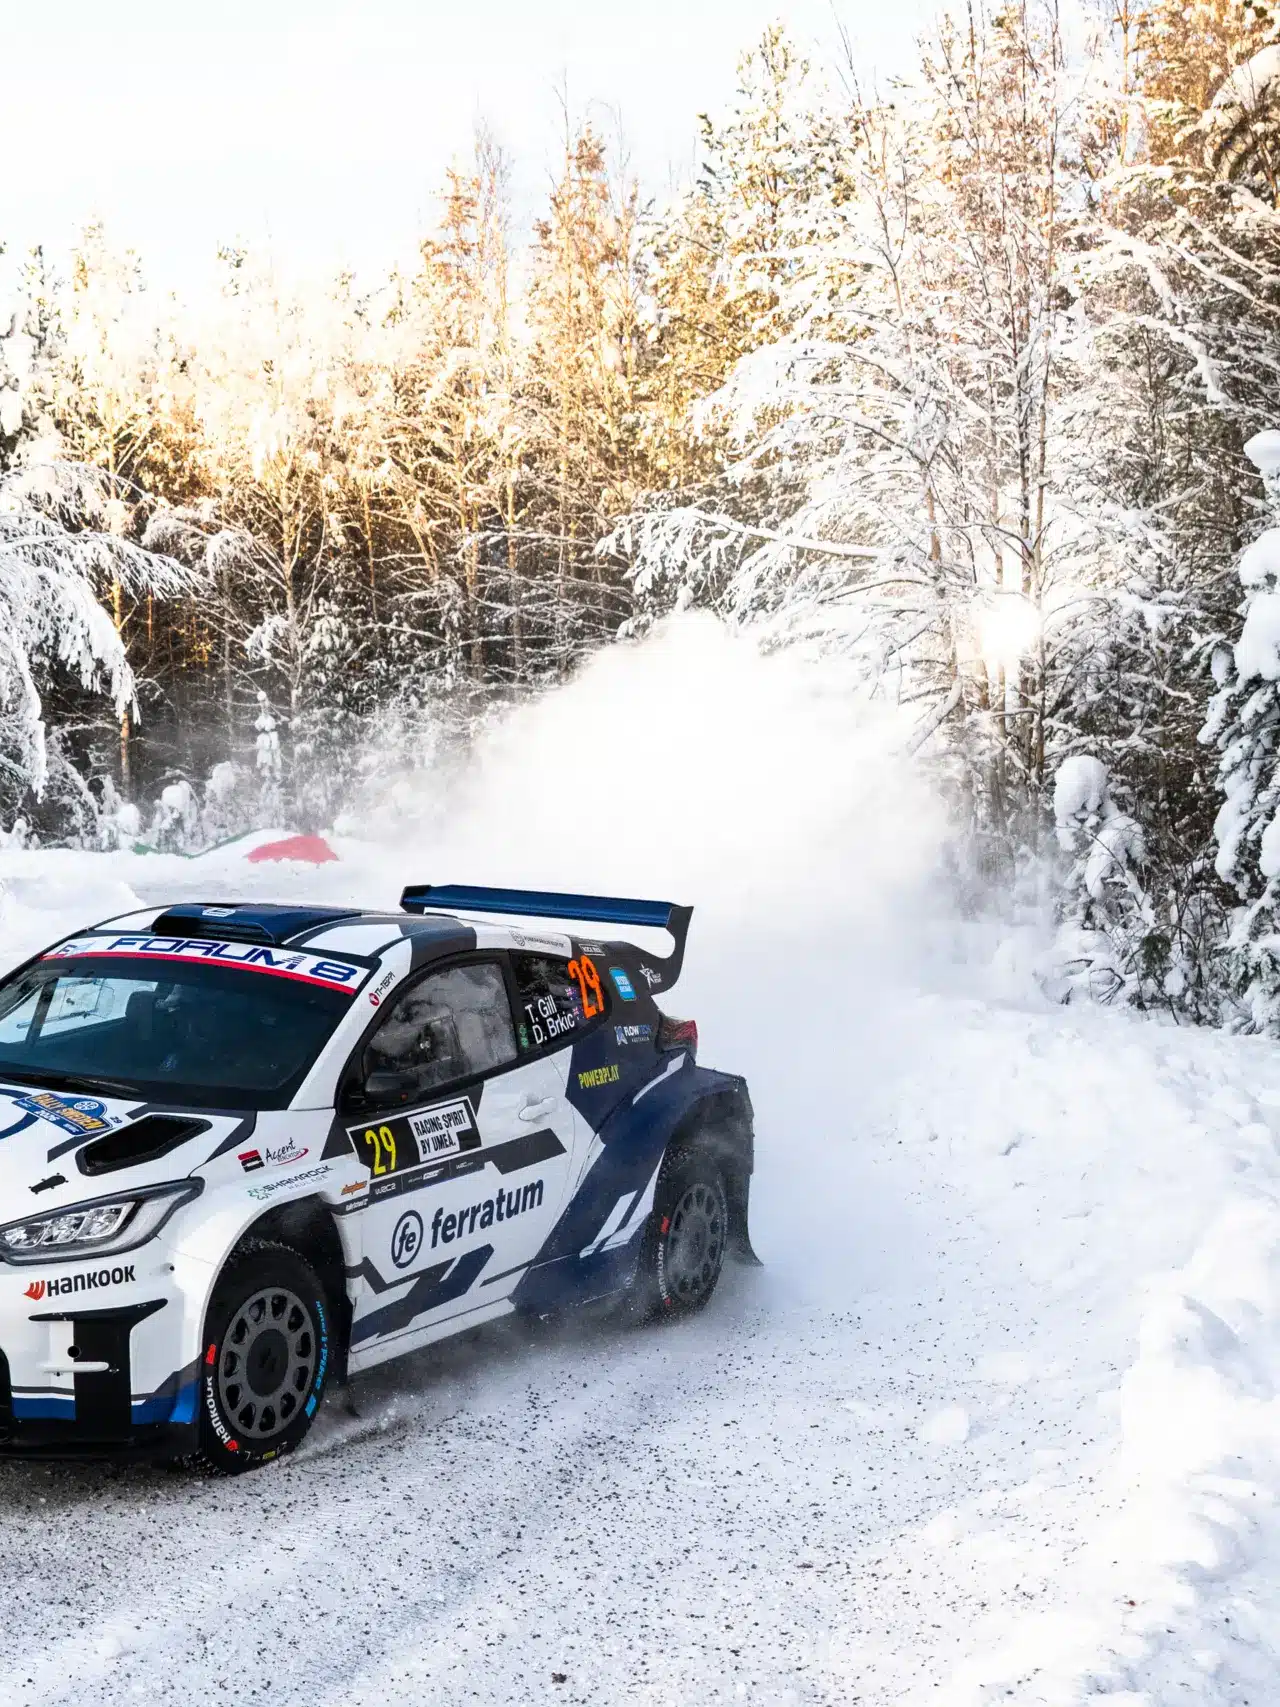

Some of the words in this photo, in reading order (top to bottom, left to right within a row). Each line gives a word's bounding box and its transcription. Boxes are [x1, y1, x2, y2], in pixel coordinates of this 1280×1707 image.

[567, 955, 604, 1020] 29
[538, 995, 558, 1018] Gill
[546, 1012, 575, 1038] Brkic
[578, 1064, 620, 1089] POWERPLAY
[413, 1118, 443, 1137] RACING
[442, 1109, 467, 1129] SPIRIT
[266, 1137, 296, 1162] Accent
[365, 1125, 397, 1175] 29
[420, 1137, 432, 1154] BY
[263, 1165, 334, 1191] SHAMROCK
[431, 1179, 544, 1249] ferratum
